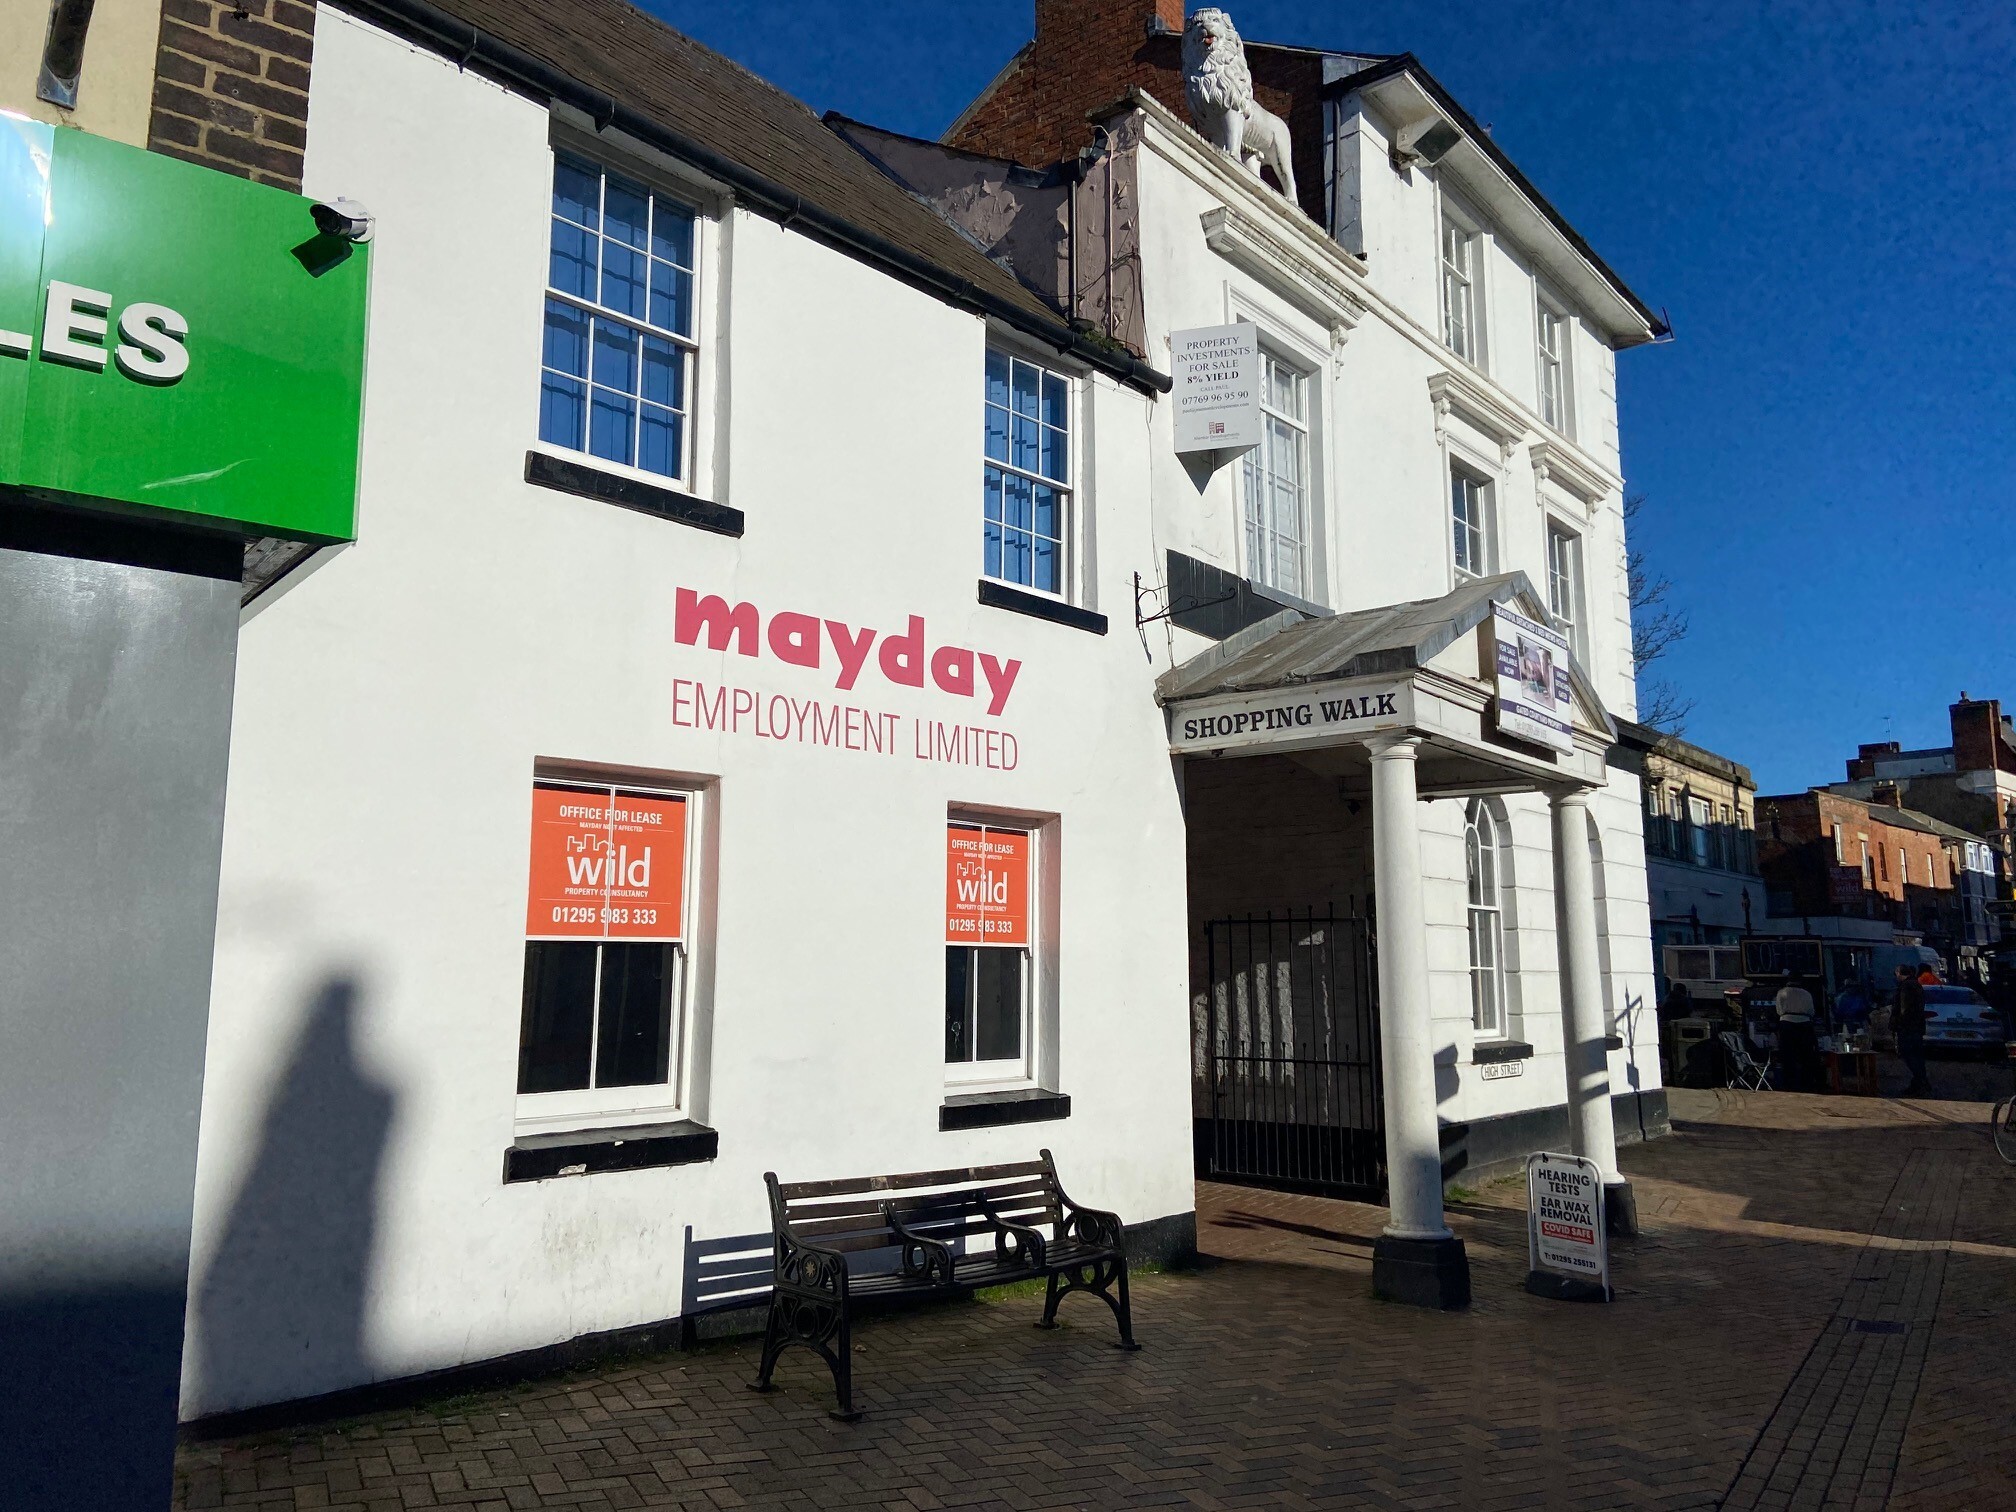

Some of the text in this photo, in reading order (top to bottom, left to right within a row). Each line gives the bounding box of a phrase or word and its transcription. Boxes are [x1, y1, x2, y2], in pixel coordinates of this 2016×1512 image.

[1187, 336, 1239, 350] PROPERTY
[1177, 346, 1251, 363] INVESTMENTS
[1189, 359, 1239, 372] FOR SALE
[1187, 371, 1239, 384] 8% YIELD
[1182, 390, 1249, 406] 07769 96 95 90
[674, 586, 1023, 717] mayday
[1498, 653, 1518, 667] AVAILABLE
[1504, 665, 1515, 676] NOW
[672, 678, 1019, 771] EMPLOYMENT LIMITED
[1184, 693, 1398, 741] SHOPPING WALK
[604, 808, 629, 822] FOR
[631, 811, 663, 825] LEASE
[978, 841, 994, 853] FOR
[994, 843, 1015, 855] LEASE
[566, 845, 652, 888] wild
[564, 887, 599, 896] PROPERTY
[956, 870, 1008, 904] wild
[552, 906, 657, 925] 01295 983 333
[949, 918, 1013, 933] 01295 983 333
[1484, 1063, 1520, 1078] HIGH STREET
[1538, 1168, 1591, 1187] HEARING
[1548, 1181, 1580, 1196] TESTS
[1541, 1196, 1591, 1215] EAR WAX
[1540, 1206, 1593, 1226] REMOVAL
[1543, 1222, 1570, 1234] COVID
[1571, 1228, 1591, 1239] SAFE
[1544, 1251, 1551, 1260] T:
[1551, 1253, 1572, 1264] 01295
